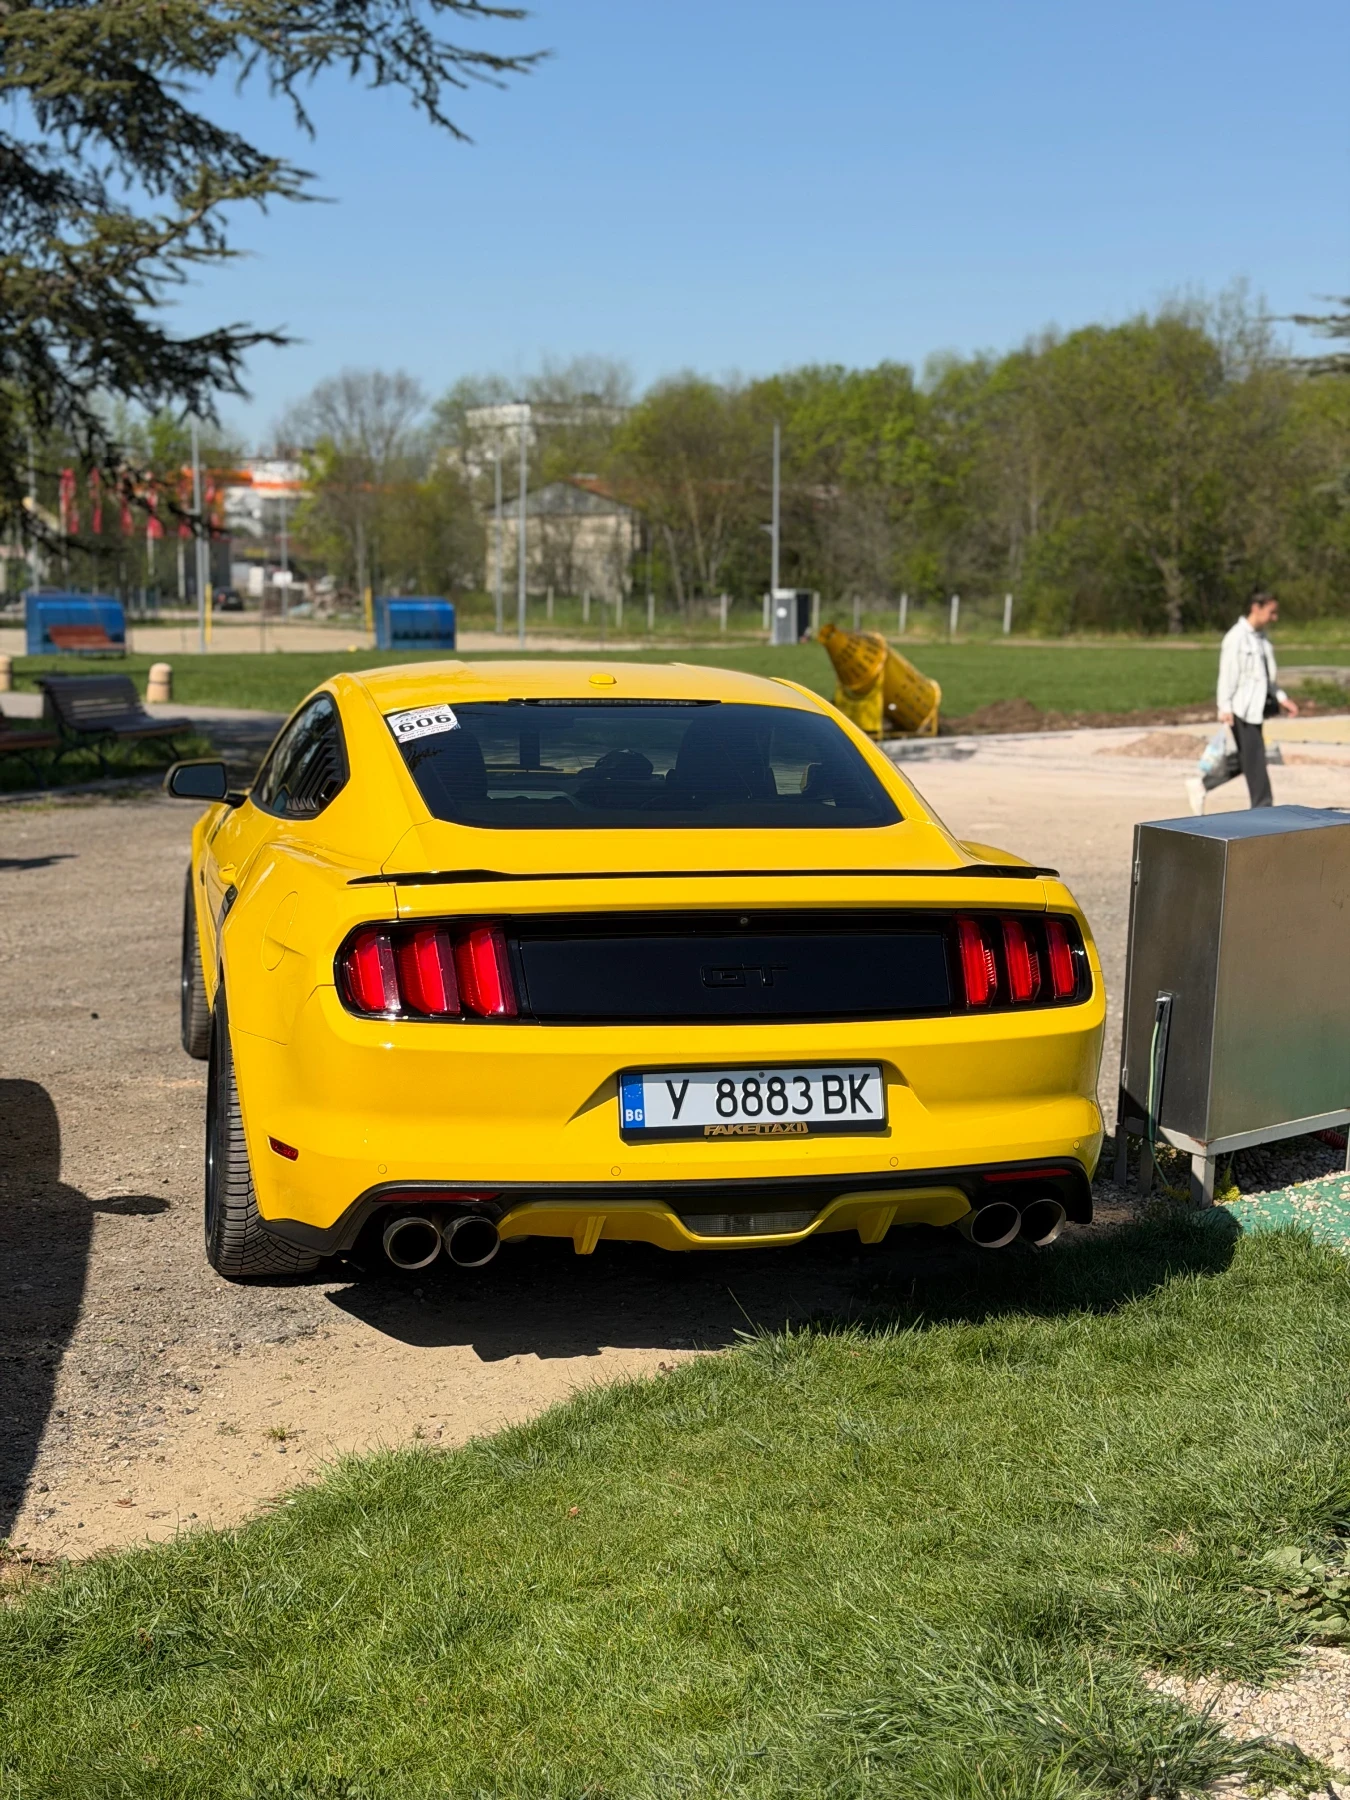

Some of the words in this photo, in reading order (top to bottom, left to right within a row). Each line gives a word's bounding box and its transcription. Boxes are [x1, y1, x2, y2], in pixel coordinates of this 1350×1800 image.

[399, 715, 451, 732] 606
[701, 964, 788, 988] GT
[716, 1075, 813, 1118] 8883
[822, 1073, 874, 1114] BK
[625, 1109, 643, 1122] BG
